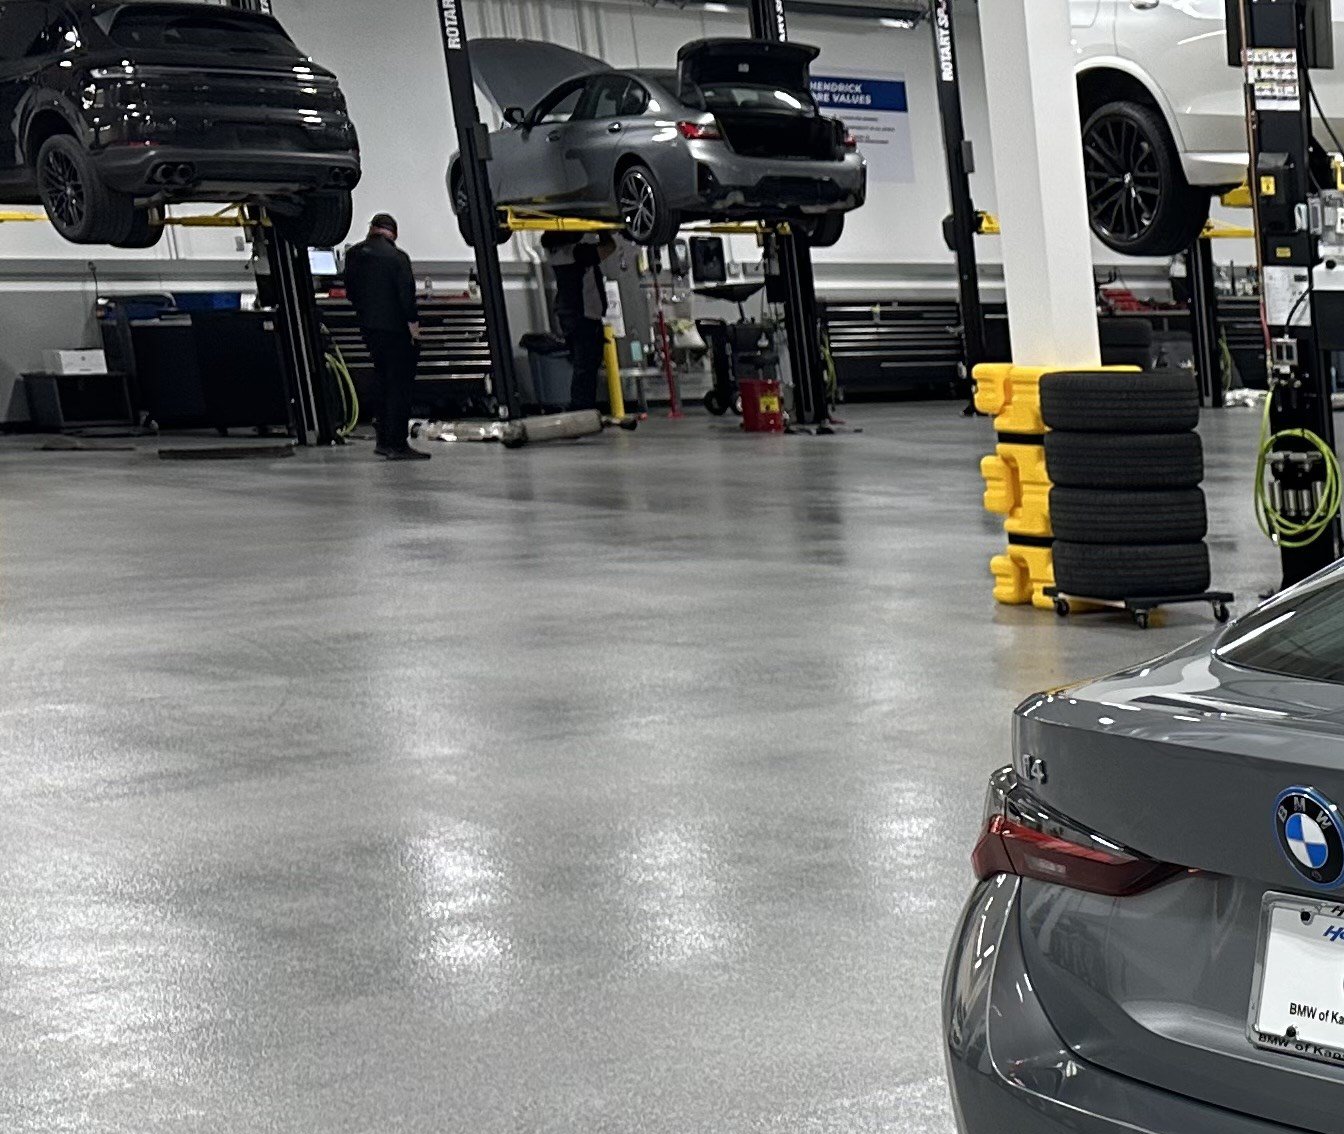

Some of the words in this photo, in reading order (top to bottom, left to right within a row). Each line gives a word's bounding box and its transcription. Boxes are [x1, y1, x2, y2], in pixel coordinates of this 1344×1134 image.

[939, 28, 954, 81] ROTARY
[809, 81, 862, 93] HENDRICK
[832, 93, 872, 105] VALUES
[1277, 796, 1333, 830] BMW
[1289, 1003, 1318, 1018] BMW
[1318, 1010, 1330, 1022] of
[1258, 1033, 1290, 1048] BMW
[1294, 1040, 1312, 1053] of
